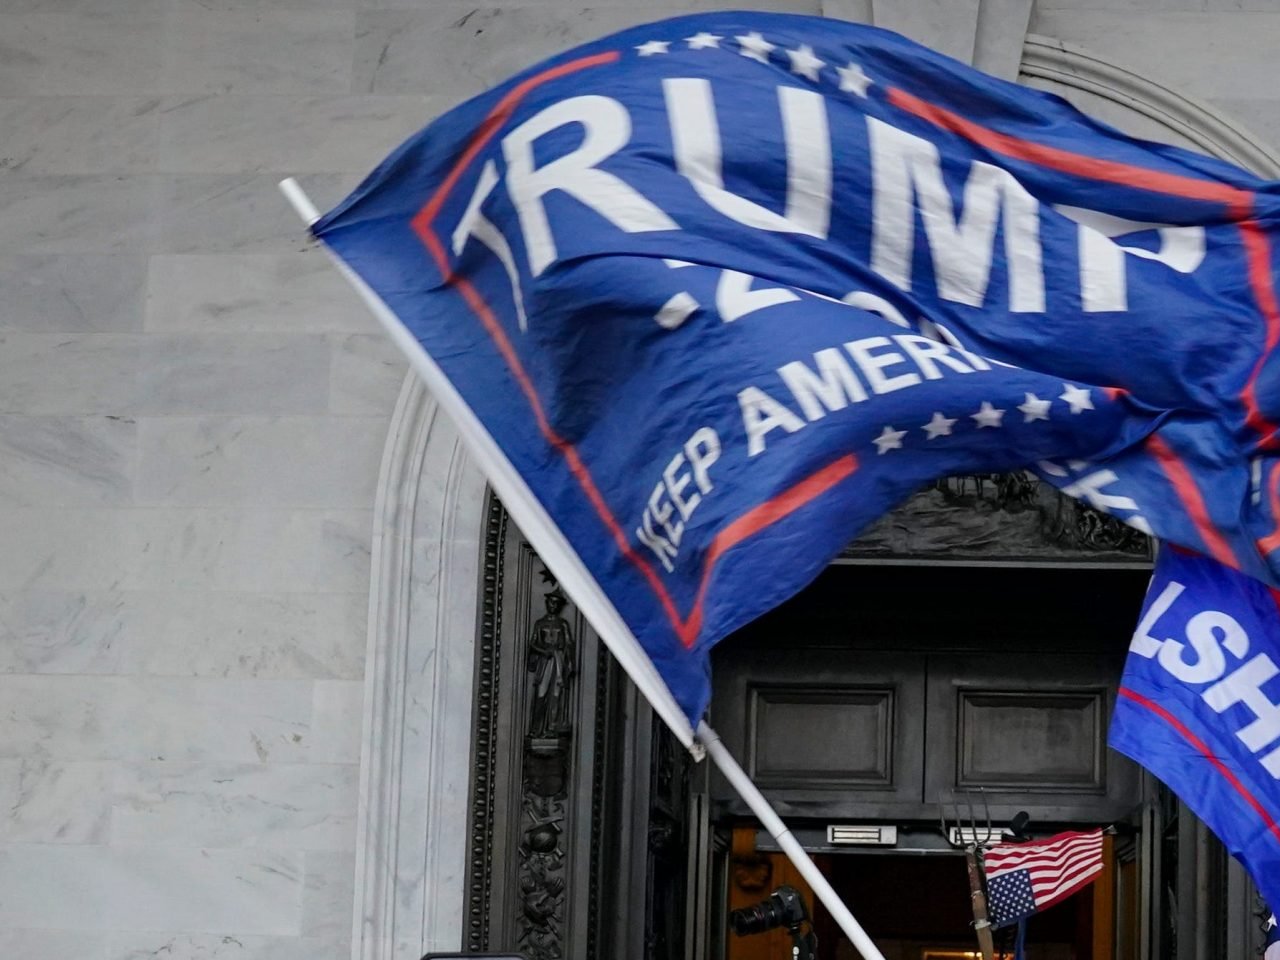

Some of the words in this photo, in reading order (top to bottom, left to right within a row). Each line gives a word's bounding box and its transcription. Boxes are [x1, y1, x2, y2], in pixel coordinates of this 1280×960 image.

[452, 78, 1206, 333] TRUMP
[636, 427, 722, 573] KEEP
[737, 334, 1018, 457] AMERI
